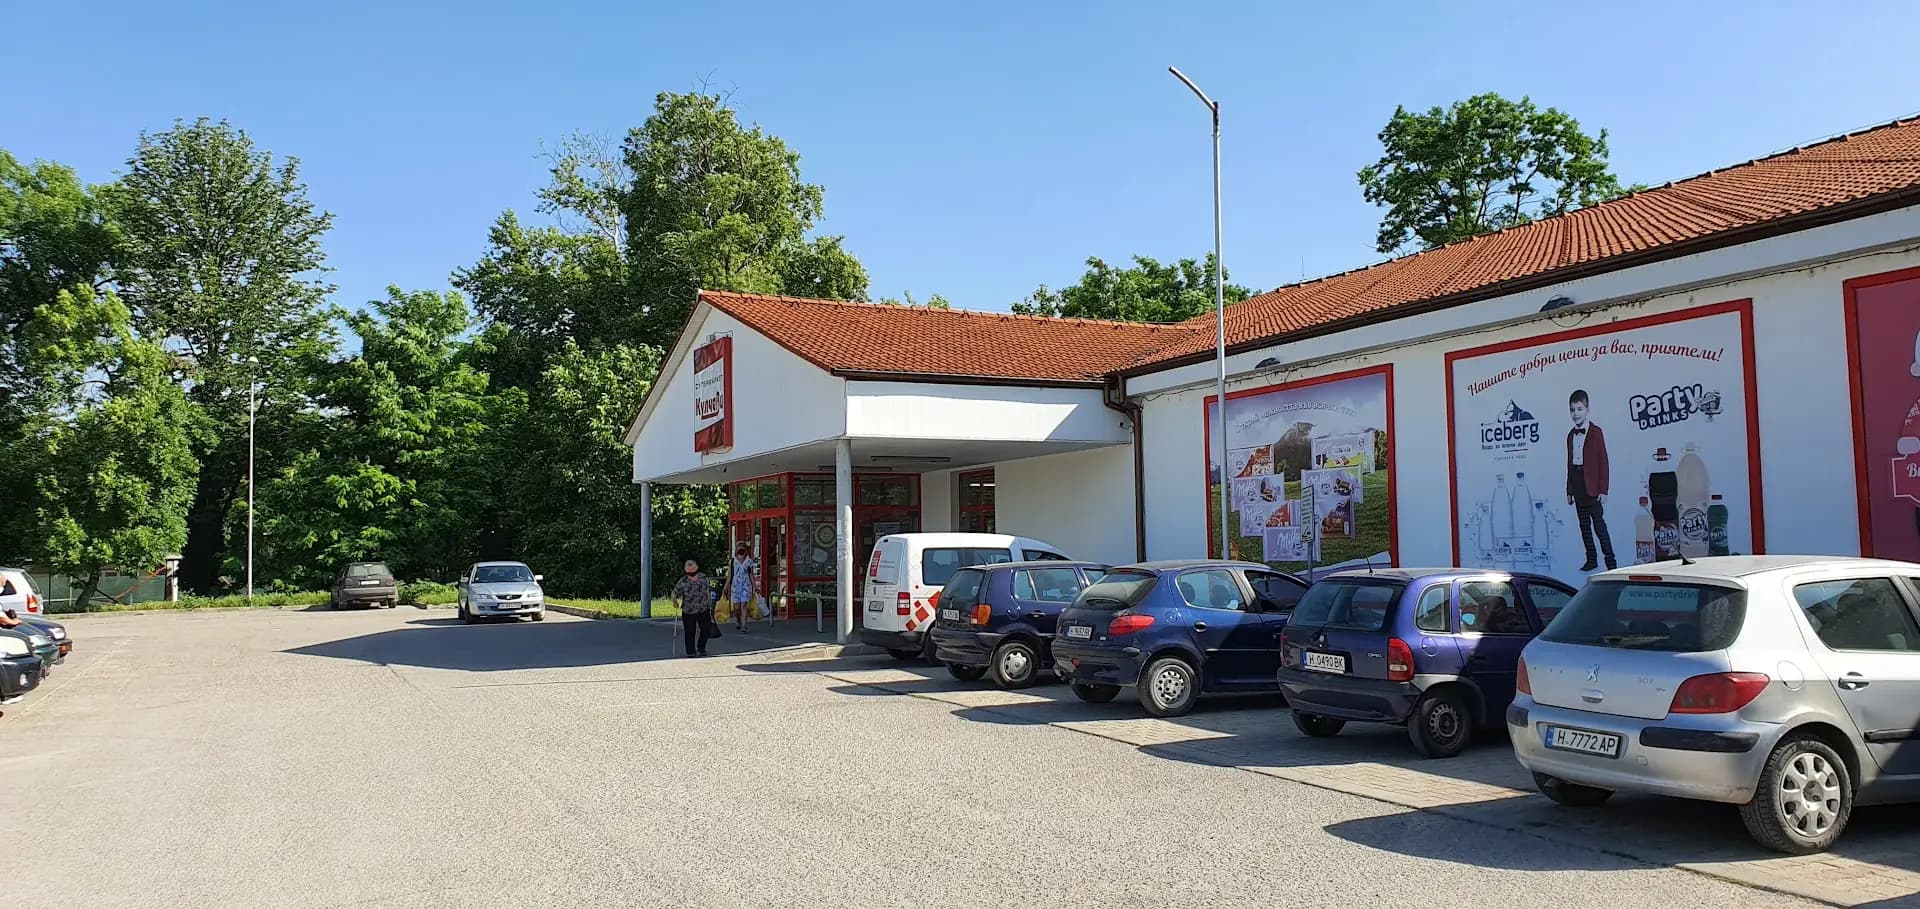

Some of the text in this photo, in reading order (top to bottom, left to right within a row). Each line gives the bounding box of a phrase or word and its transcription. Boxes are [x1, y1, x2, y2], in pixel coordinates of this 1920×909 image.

[1467, 339, 1724, 396] Нашите добри цени за вас, приятели!
[1629, 384, 1702, 421] Party
[1480, 421, 1540, 443] iceberg
[1639, 409, 1689, 430] DRINKS
